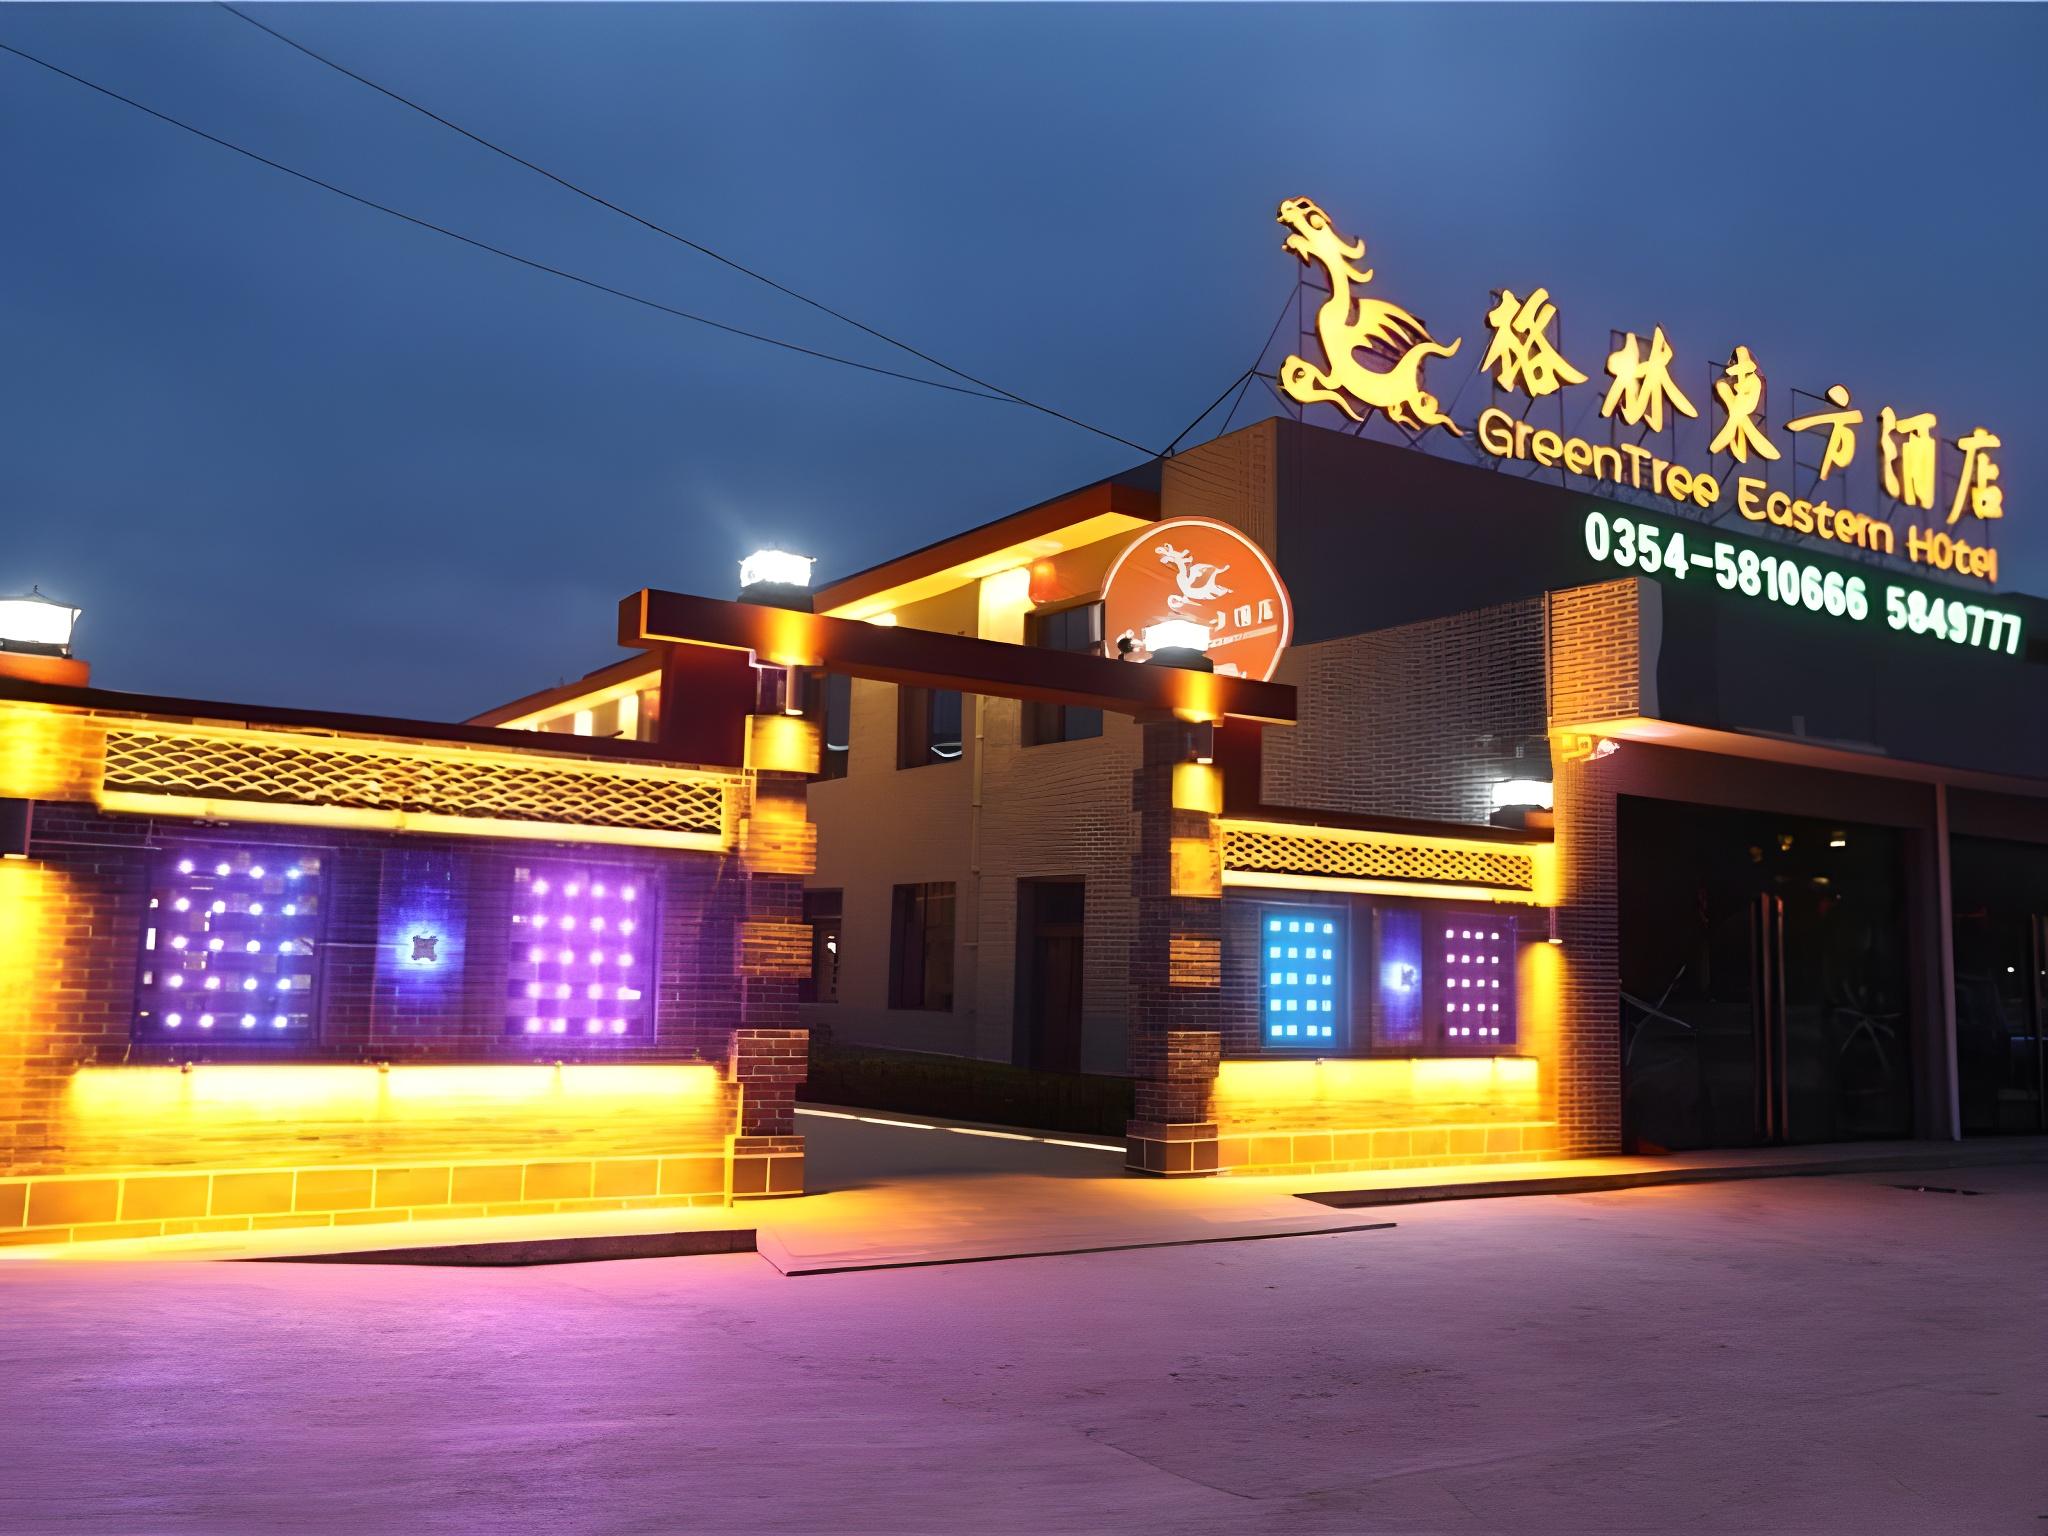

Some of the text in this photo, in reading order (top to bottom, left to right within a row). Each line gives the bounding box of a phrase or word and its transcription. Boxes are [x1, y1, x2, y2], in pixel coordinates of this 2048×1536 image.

[1478, 407, 1720, 508] GreenTree
[1737, 476, 1893, 555] Eastern
[1585, 511, 2021, 654] 0354-5810666 5849777
